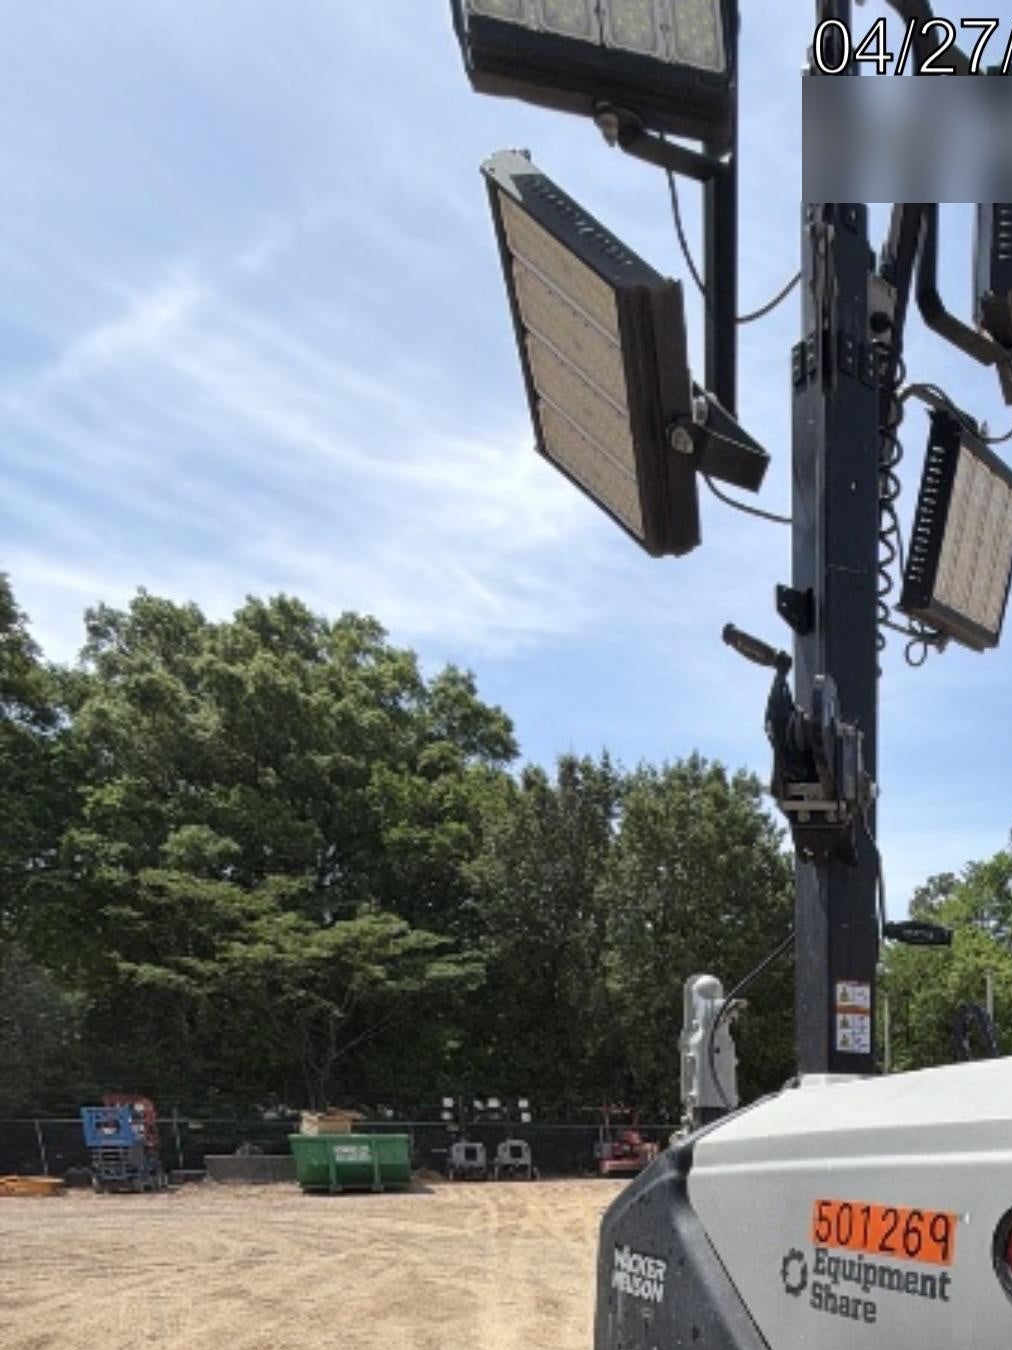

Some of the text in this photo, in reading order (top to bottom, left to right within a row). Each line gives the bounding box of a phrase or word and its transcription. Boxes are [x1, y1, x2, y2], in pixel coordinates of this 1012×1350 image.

[815, 1199, 950, 1261] 501269
[810, 1281, 876, 1323] Share
[812, 1248, 952, 1302] Equipment
